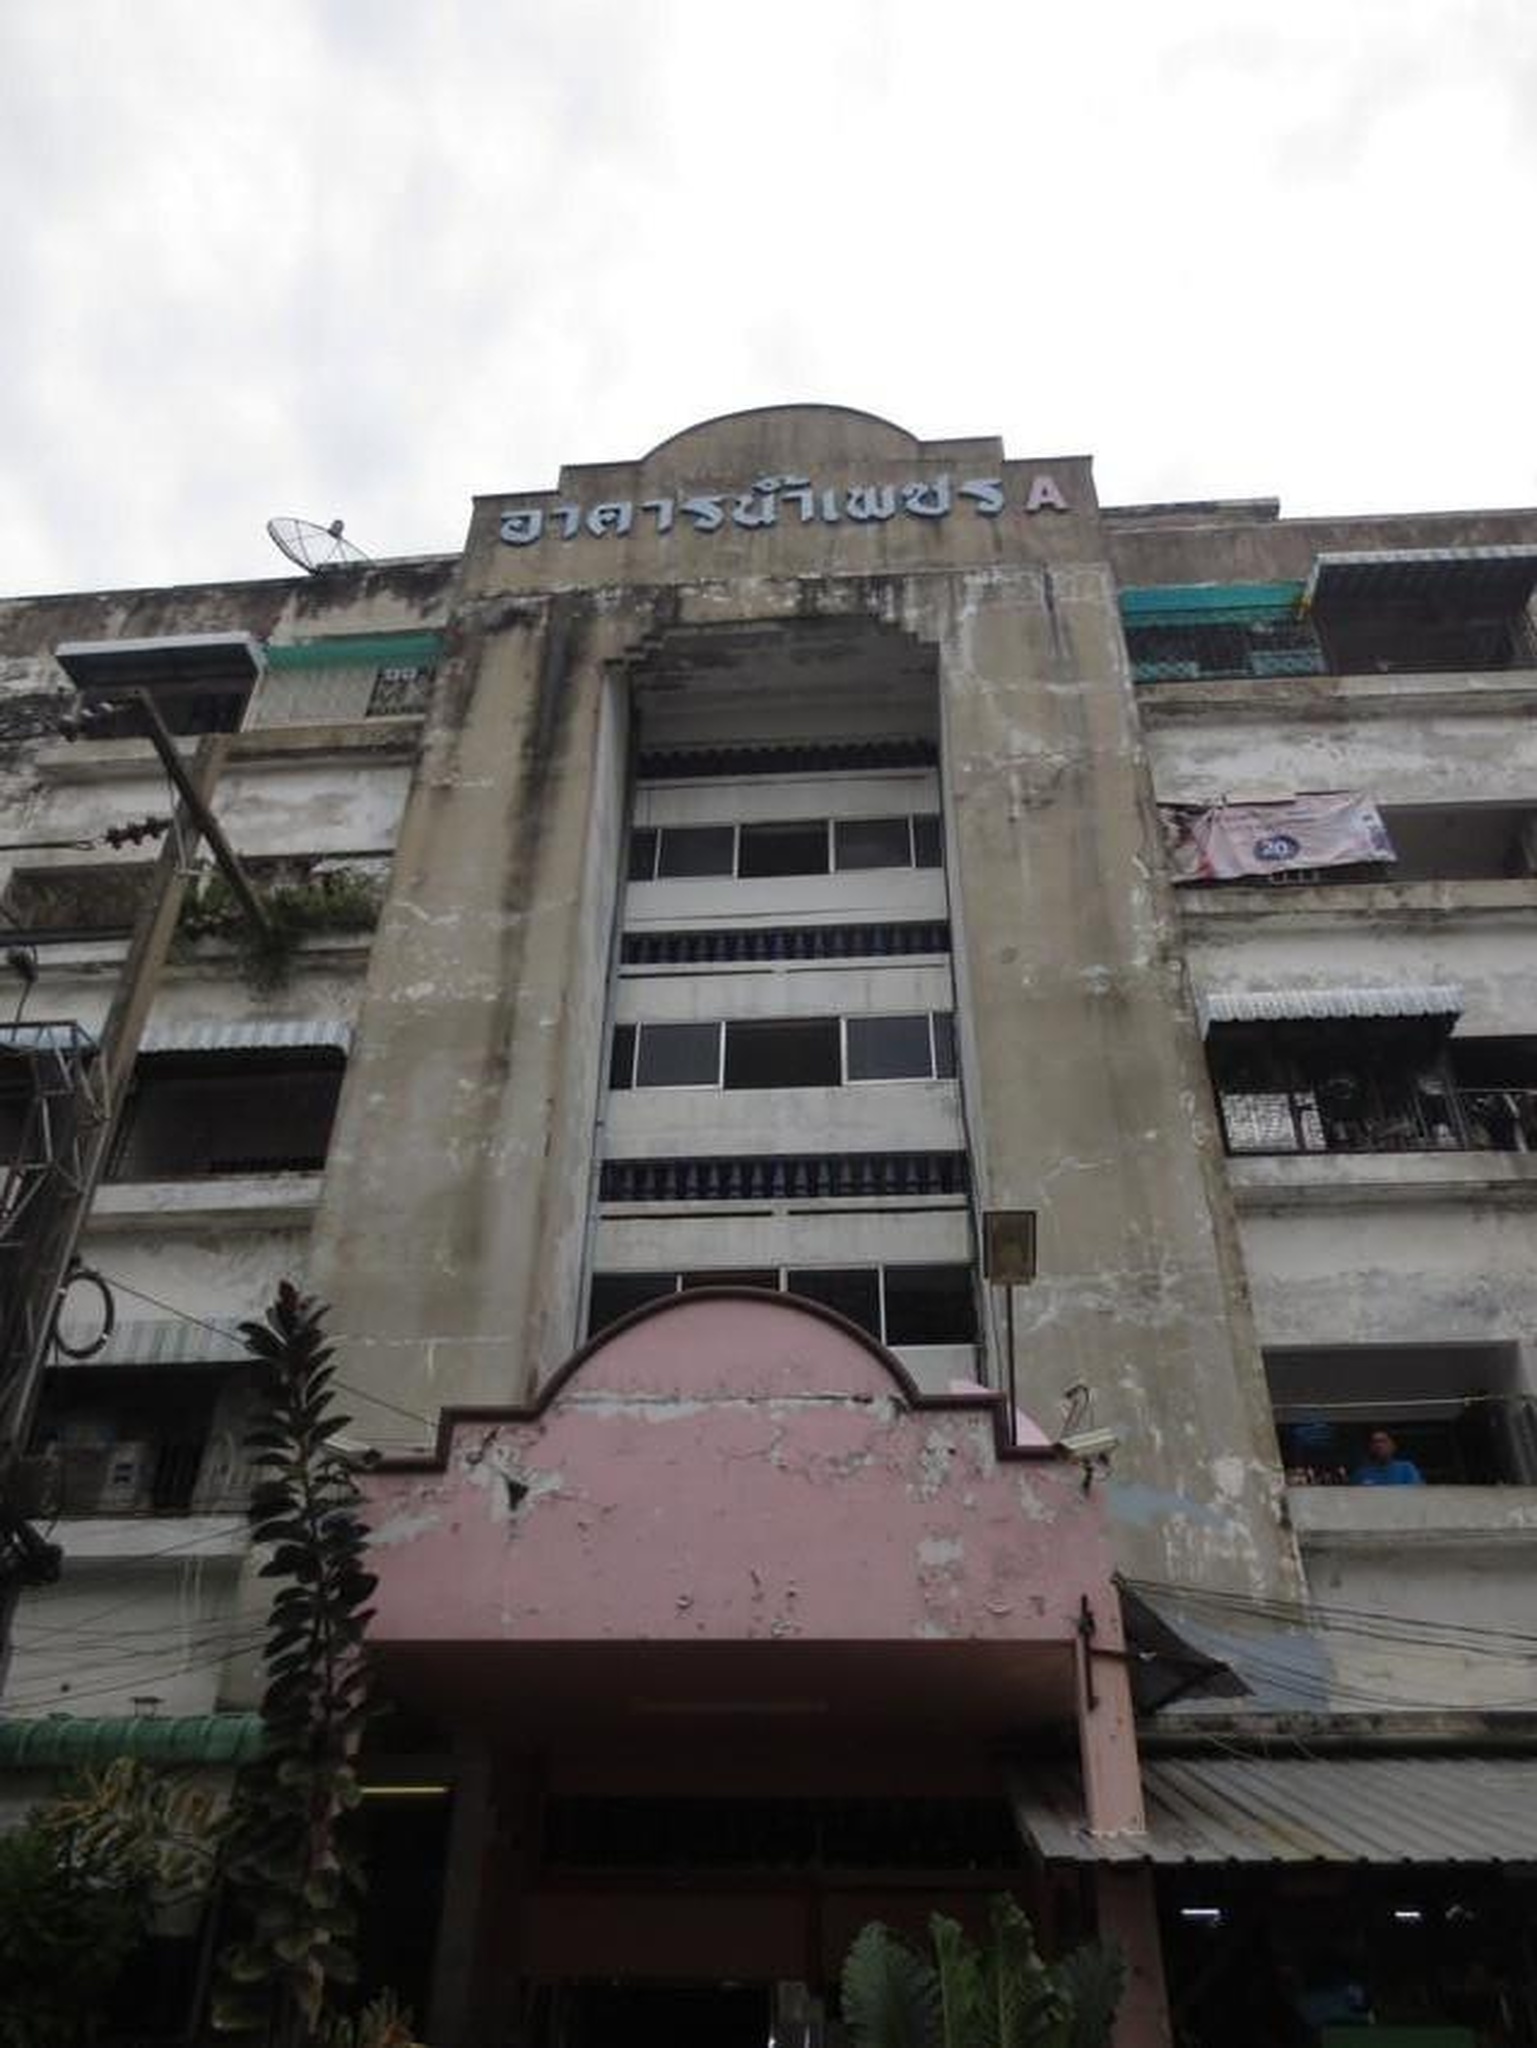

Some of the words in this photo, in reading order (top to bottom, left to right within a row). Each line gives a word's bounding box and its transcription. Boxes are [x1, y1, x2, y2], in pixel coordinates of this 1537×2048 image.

[500, 475, 1004, 545] อาคารน้ำเพชร
[1025, 475, 1067, 513] A
